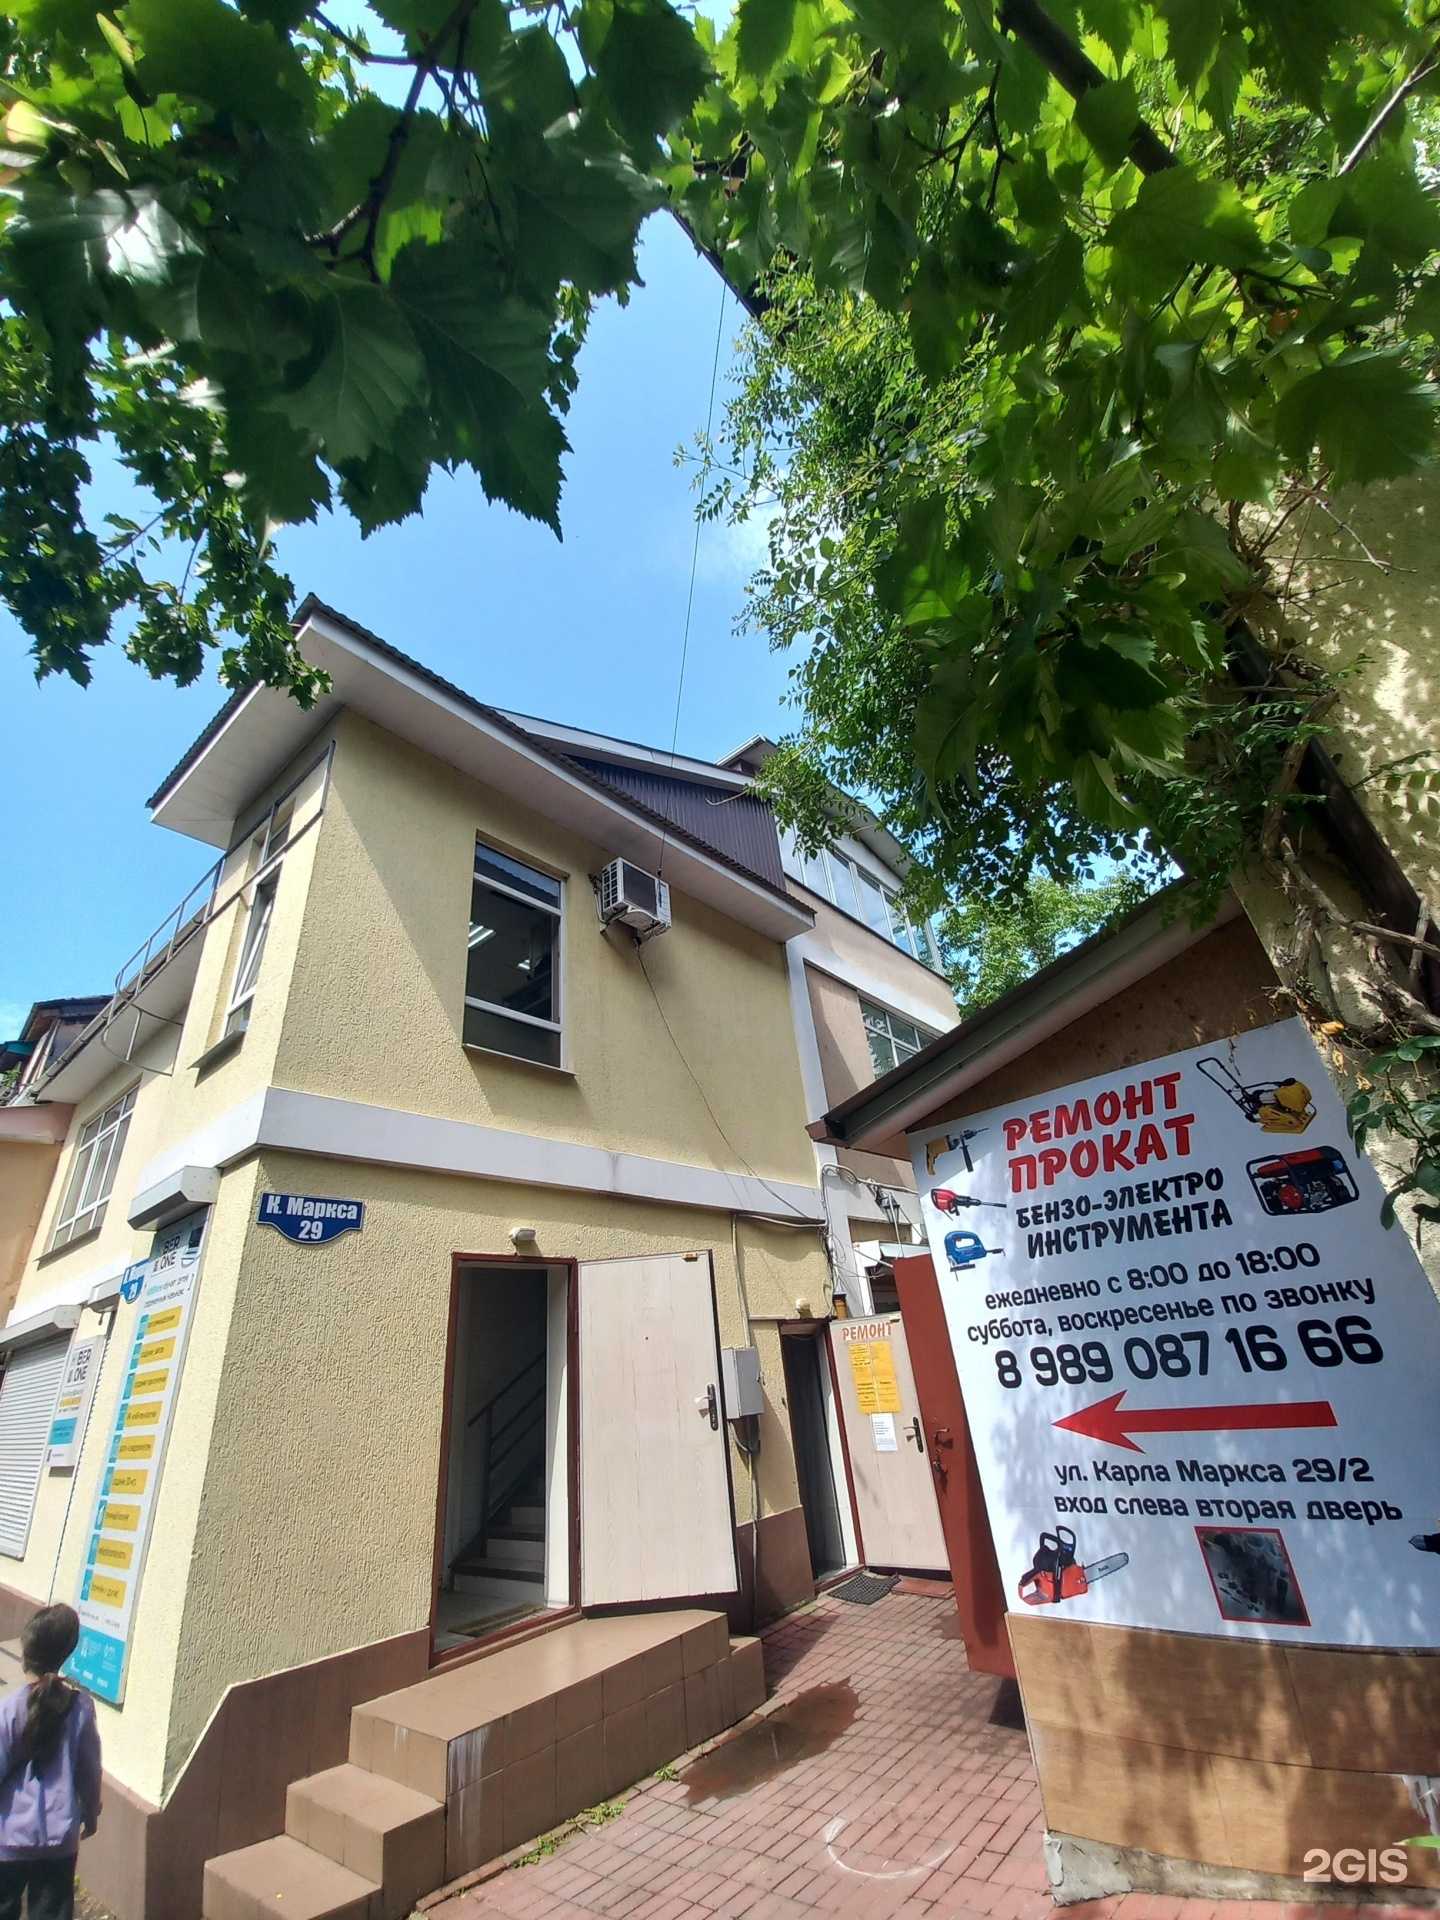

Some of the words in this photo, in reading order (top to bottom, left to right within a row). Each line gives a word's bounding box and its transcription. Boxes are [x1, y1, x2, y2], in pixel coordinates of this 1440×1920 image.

[1002, 1072, 1182, 1151] РЕМОНТ
[1008, 1113, 1195, 1193] ПРОКАТ
[266, 1195, 283, 1215] К.
[286, 1197, 358, 1219] Маркса
[1016, 1167, 1224, 1228] БЕНЗО-ЭЛЕКТРО
[298, 1220, 323, 1239] 29
[1027, 1198, 1233, 1259] ИНСТРУМЕНТА
[985, 1279, 1101, 1310] ежедневно
[1107, 1276, 1123, 1294] с
[1126, 1262, 1189, 1290] 8:00
[1198, 1261, 1231, 1282] до
[1235, 1242, 1321, 1276] 18:00
[841, 1321, 893, 1341] РЕМОНТ
[967, 1316, 1053, 1345] суббота,
[1057, 1298, 1215, 1332] воскресенье
[1220, 1292, 1257, 1314] по
[1264, 1278, 1376, 1309] звонку
[995, 1350, 1022, 1389] 8
[1030, 1341, 1114, 1386] 989
[1123, 1330, 1209, 1380] 087
[1225, 1324, 1288, 1373] 16
[1297, 1315, 1384, 1368] 66
[1054, 1464, 1088, 1485] ул.
[1092, 1460, 1171, 1486] Карла
[1175, 1460, 1287, 1487] Маркса
[1292, 1457, 1375, 1482] 29/2
[1054, 1496, 1108, 1514] вход
[1114, 1497, 1190, 1516] слева
[1195, 1499, 1297, 1523] вторая
[1306, 1500, 1403, 1526] дверь
